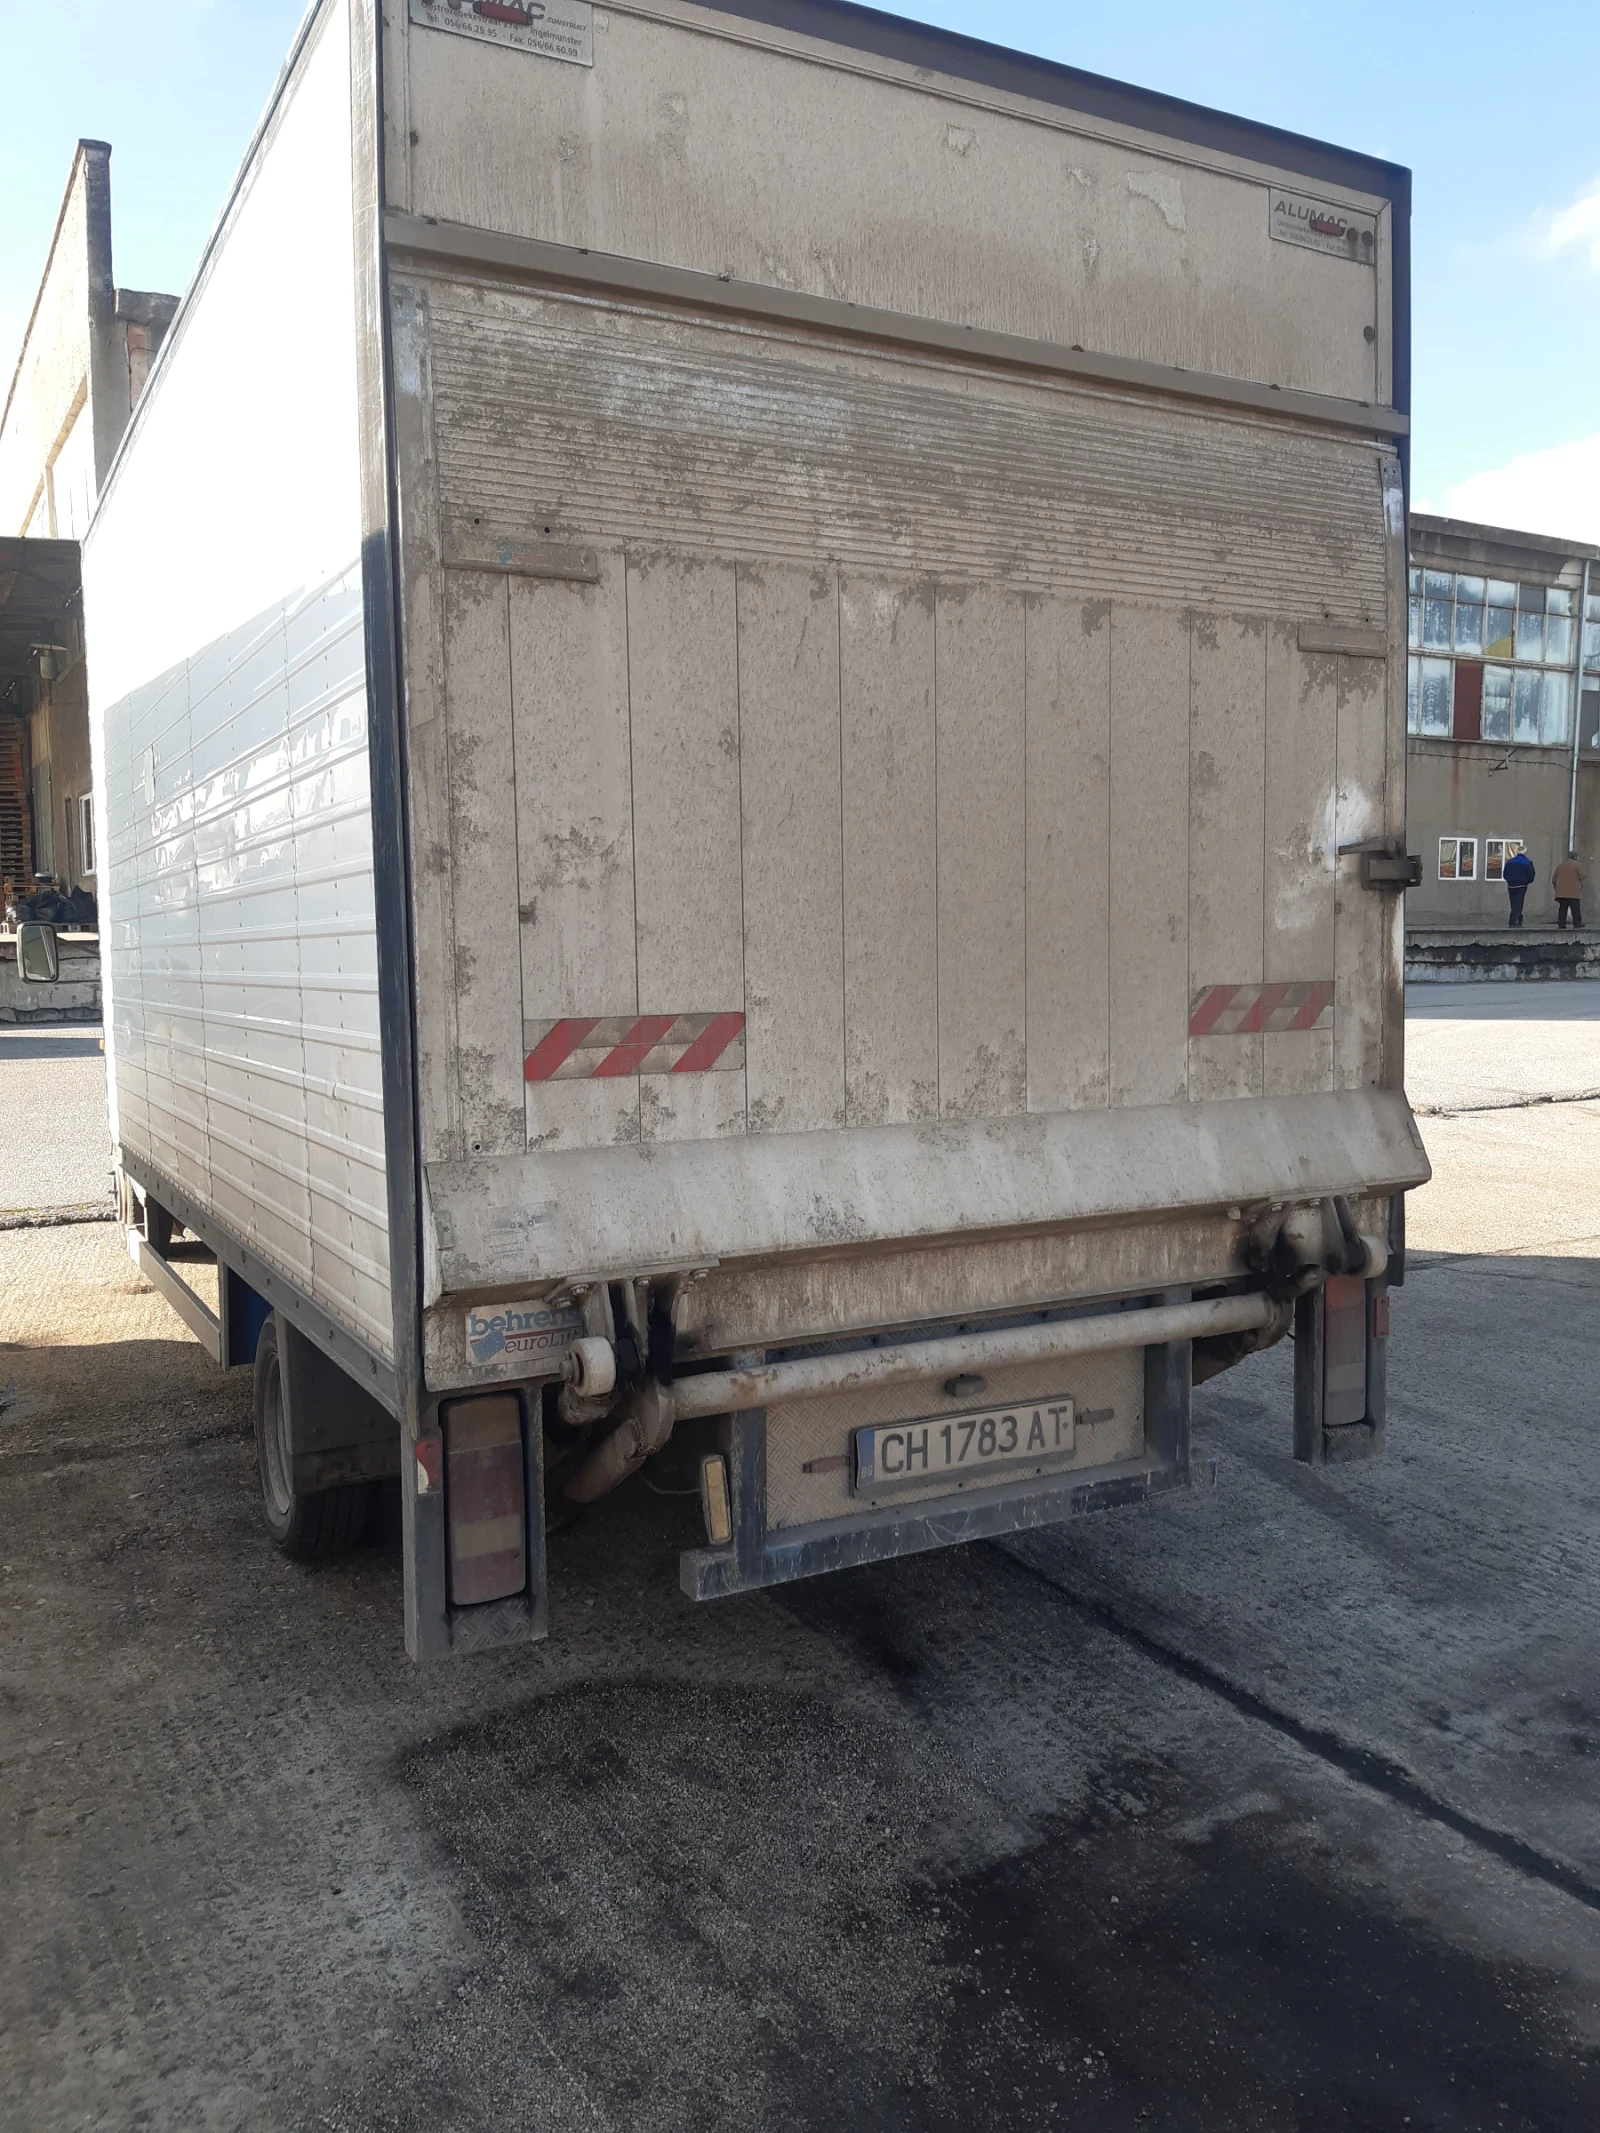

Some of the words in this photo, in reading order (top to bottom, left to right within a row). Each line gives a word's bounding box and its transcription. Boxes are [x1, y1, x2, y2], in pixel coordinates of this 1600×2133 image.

[426, 13, 440, 23] Tel:
[445, 18, 498, 38] 056/66.25.95
[509, 33, 525, 45] Fax:
[528, 38, 578, 57] 056/66.60.99
[530, 26, 582, 46] Ingelmunster
[547, 17, 587, 31] CONSTRUCT
[860, 1464, 873, 1478] BG
[881, 1429, 928, 1474] CH
[940, 1415, 1018, 1464] 1783
[1026, 1406, 1068, 1450] AT
